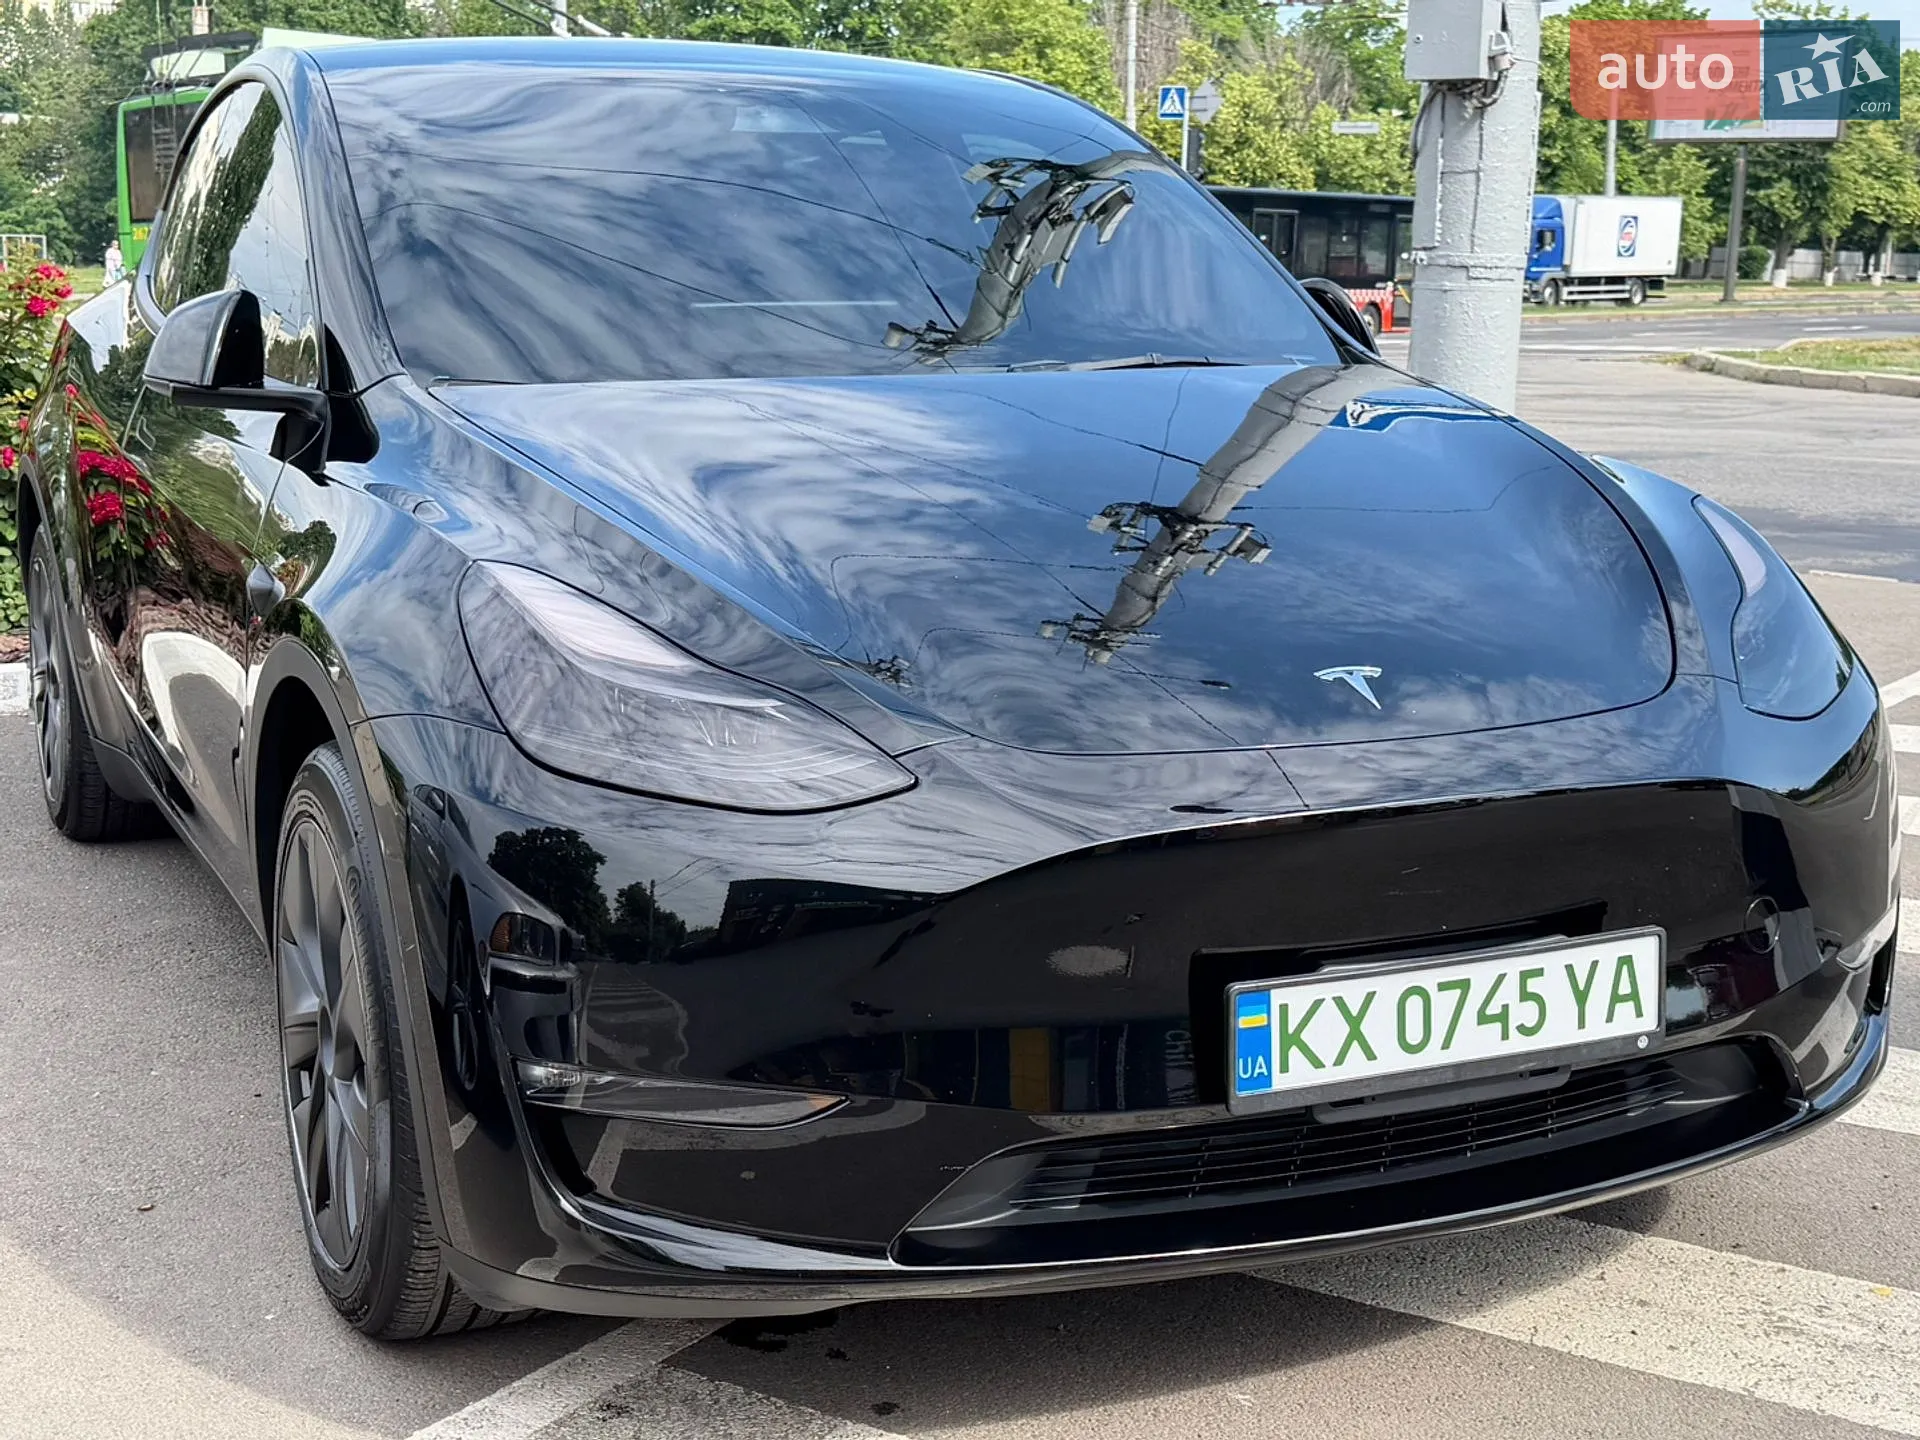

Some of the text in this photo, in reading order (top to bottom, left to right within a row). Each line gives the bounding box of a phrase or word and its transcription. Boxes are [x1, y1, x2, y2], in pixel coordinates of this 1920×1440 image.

[1278, 954, 1644, 1074] KX 0745 YA
[1238, 1055, 1269, 1080] UA
